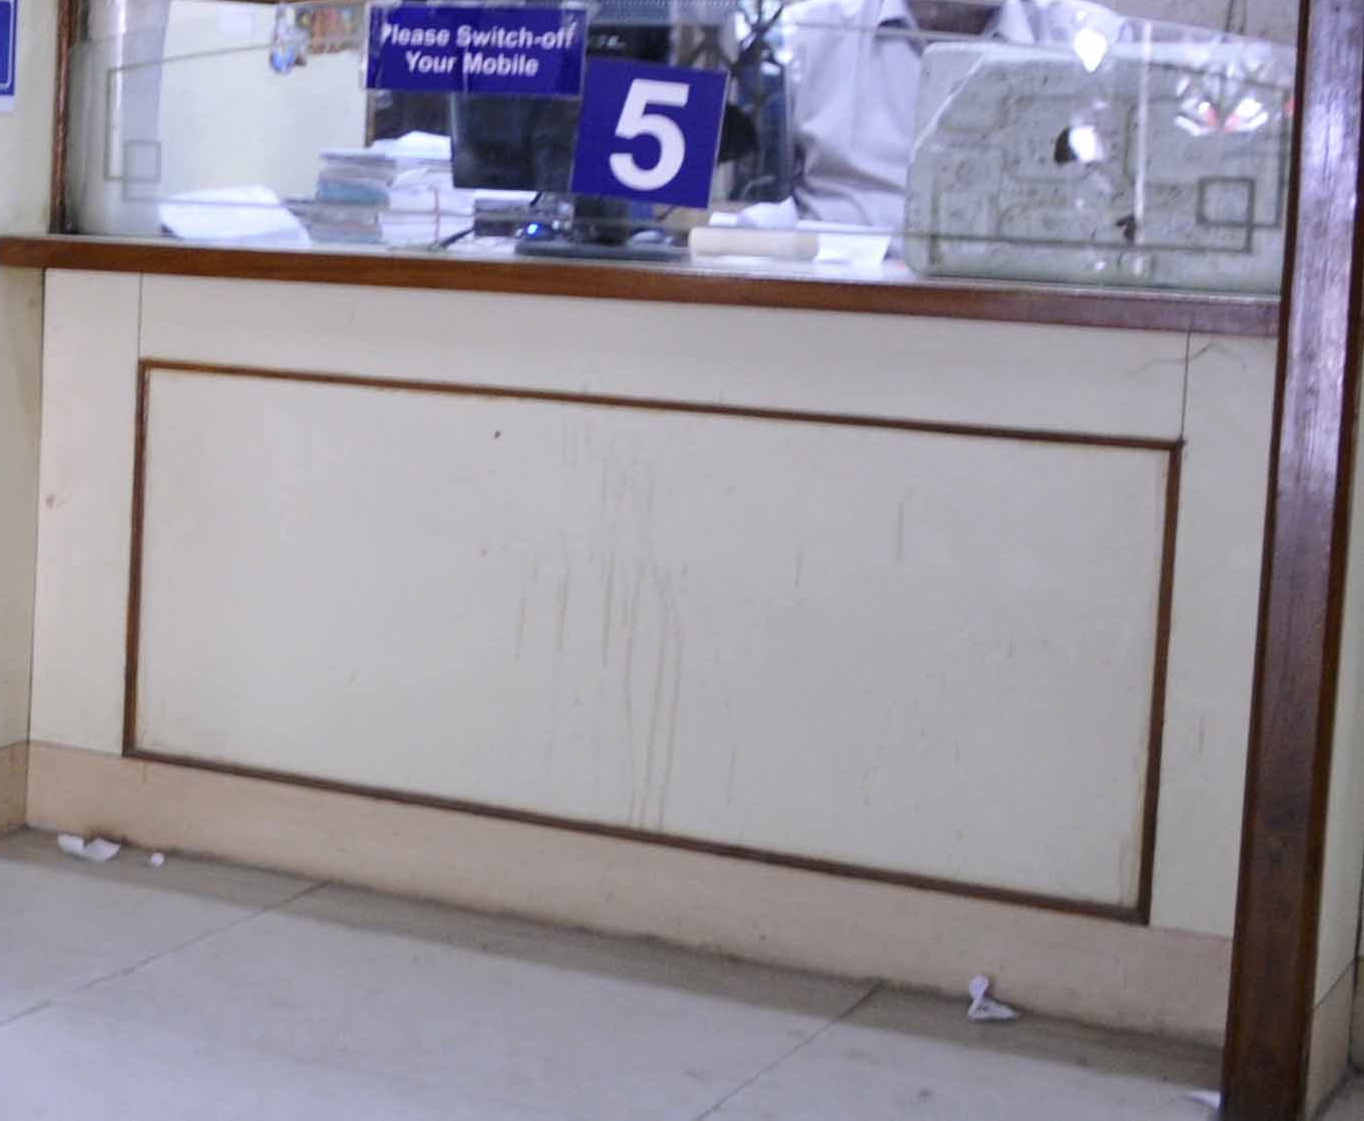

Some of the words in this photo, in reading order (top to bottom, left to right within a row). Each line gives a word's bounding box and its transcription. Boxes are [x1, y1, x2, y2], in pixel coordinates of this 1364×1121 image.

[380, 22, 450, 47] Please
[456, 22, 577, 49] Switch-off
[404, 50, 457, 75] Your
[463, 52, 539, 77] Mobile
[609, 78, 691, 192] 5
